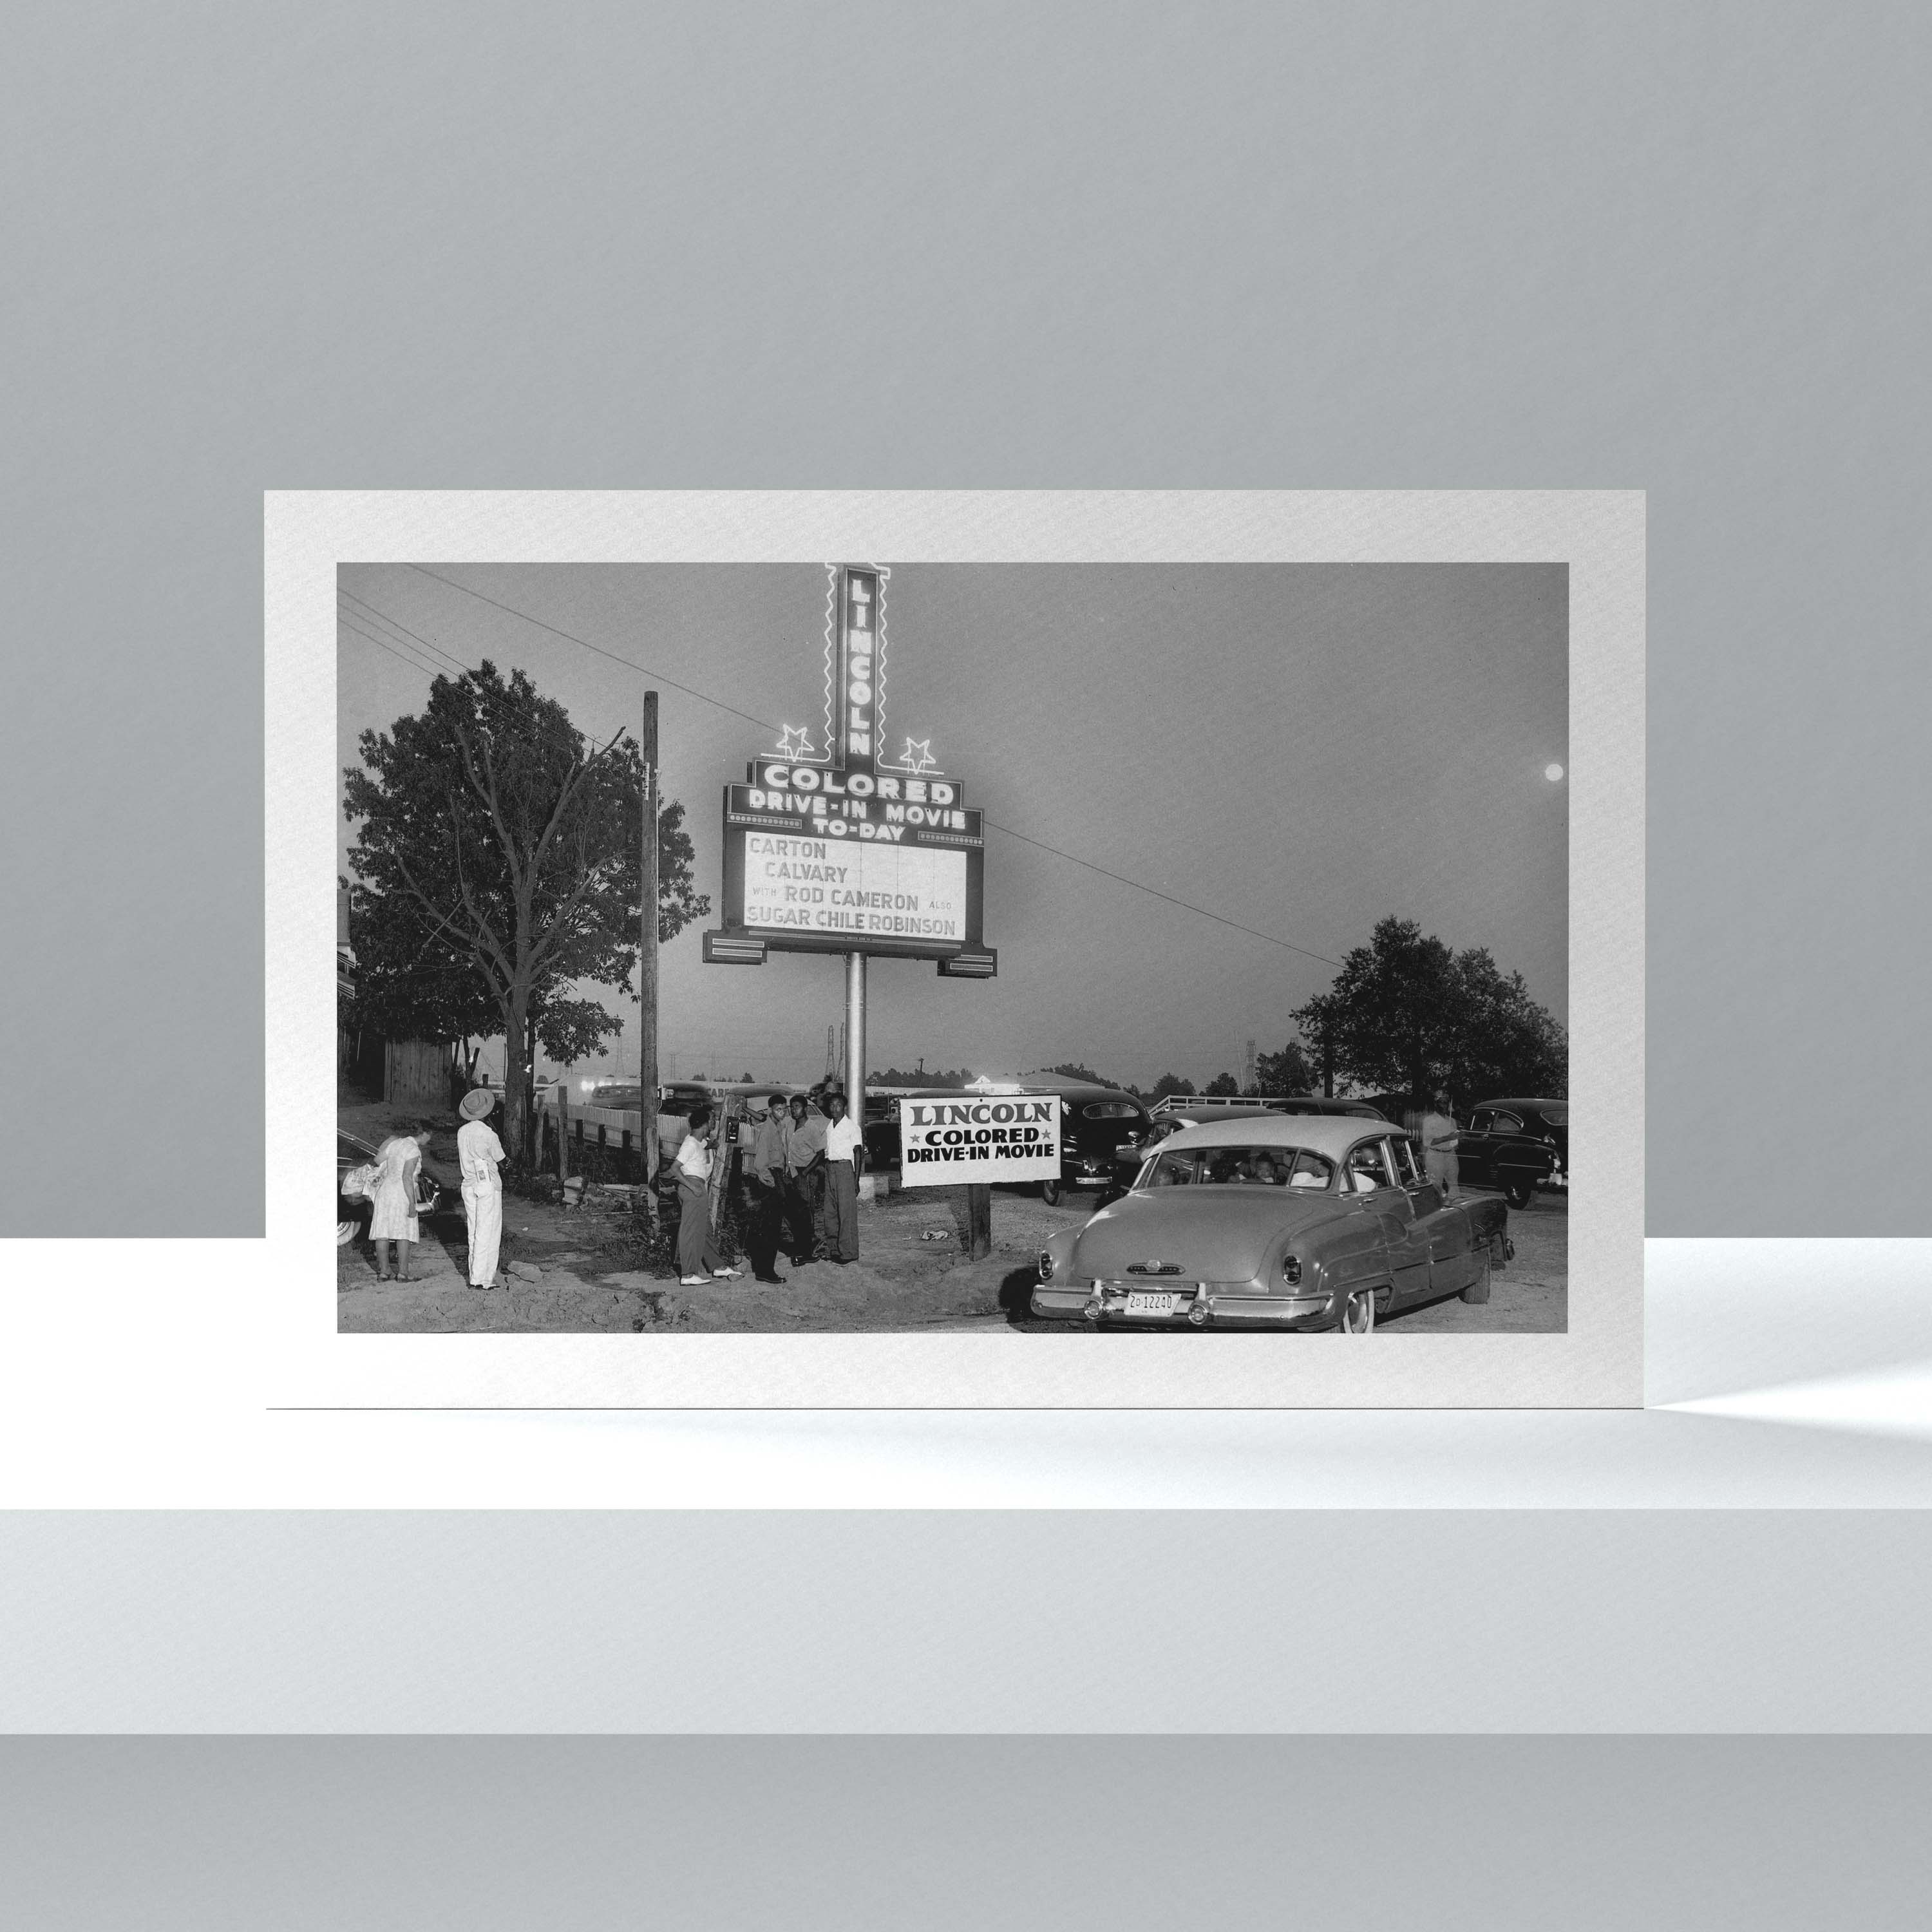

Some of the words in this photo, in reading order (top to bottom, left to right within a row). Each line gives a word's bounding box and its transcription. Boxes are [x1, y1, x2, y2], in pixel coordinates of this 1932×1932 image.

[849, 579, 872, 755] LINCOLN
[764, 764, 954, 805] COLORED
[749, 789, 867, 819] DRIVE-IN
[886, 804, 966, 829] MOVIE
[813, 817, 905, 841] TO-DAY
[750, 838, 826, 860] CARTON
[765, 862, 848, 883] CALVARY
[752, 886, 777, 897] WITH
[784, 885, 824, 904] ROD
[831, 889, 918, 911] CAMERON
[929, 902, 952, 910] ALSO
[747, 905, 811, 926] SUGAR
[815, 910, 865, 929] CHILE
[869, 913, 956, 936] ROBINSON
[910, 1103, 1053, 1126] LINCOLN
[925, 1128, 1039, 1146] COLORED
[907, 1146, 989, 1163] DRIVE-IN
[995, 1144, 1054, 1159] MOVIE
